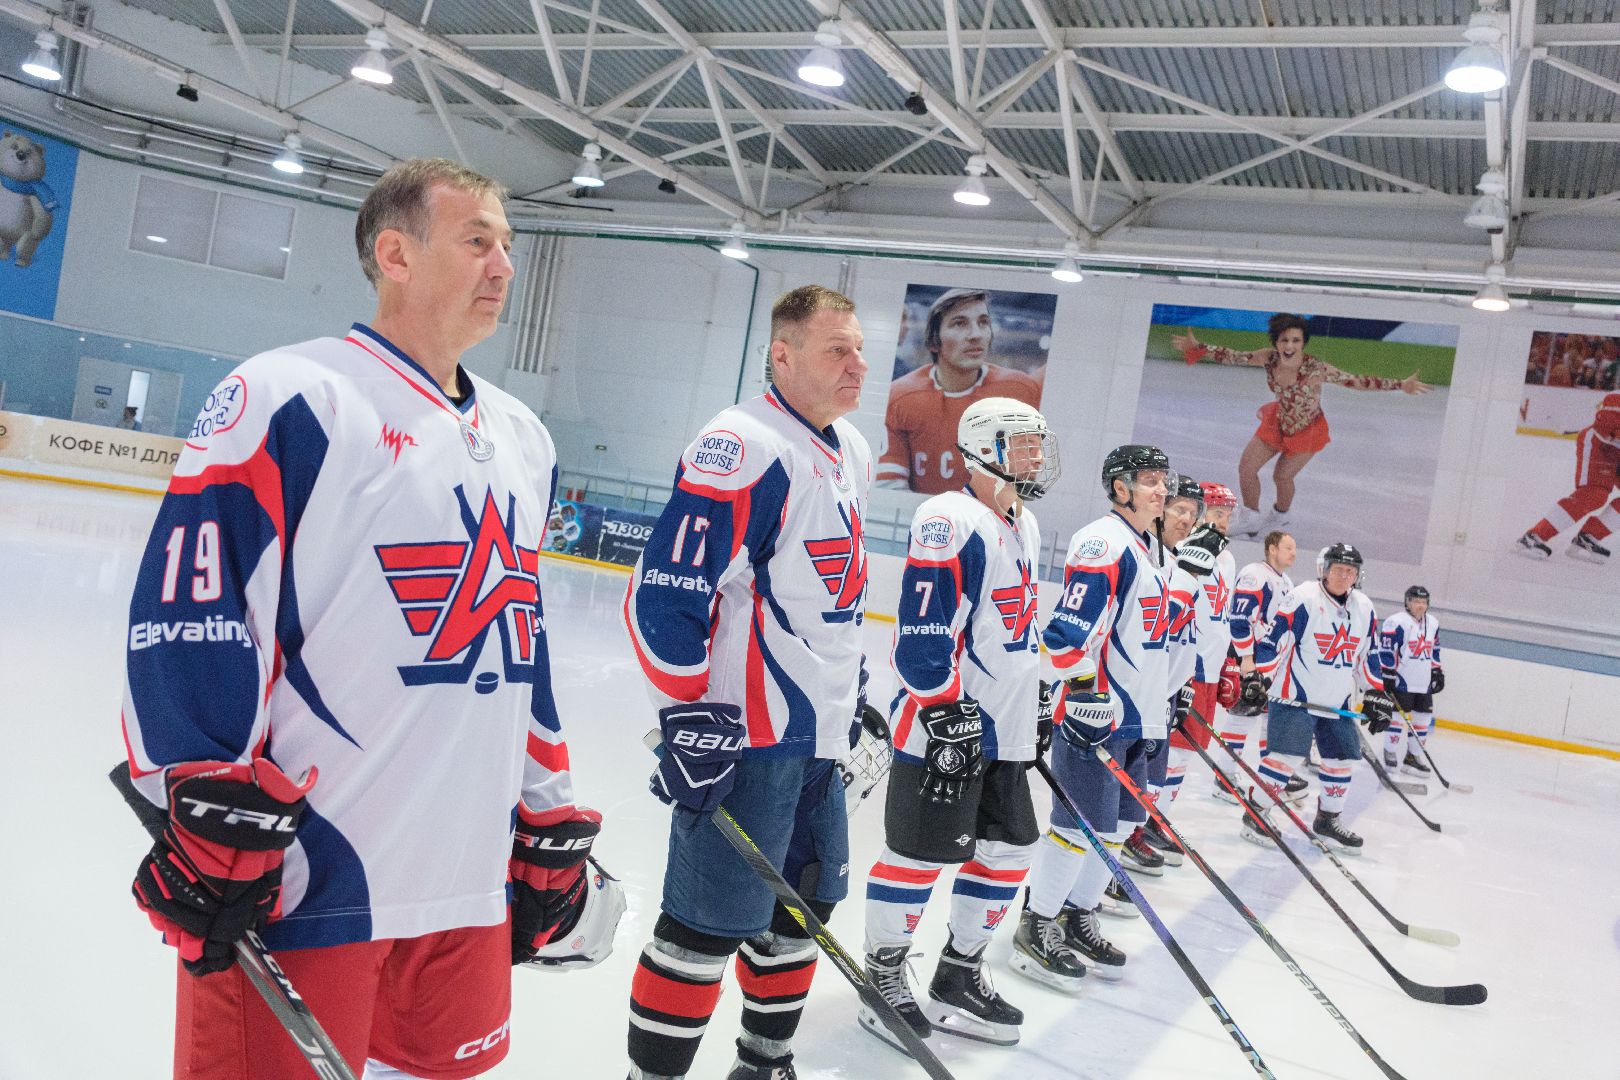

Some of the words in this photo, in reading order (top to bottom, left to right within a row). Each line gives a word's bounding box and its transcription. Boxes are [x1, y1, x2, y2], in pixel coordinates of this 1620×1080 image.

[49, 434, 104, 455] КОФЕ
[109, 443, 137, 459] №1
[140, 448, 179, 465] ДЛЯ
[695, 451, 734, 471] HOUSE
[700, 437, 741, 455] NORTH
[671, 514, 711, 567] 17
[921, 521, 950, 533] NORTH
[161, 520, 223, 603] 19
[915, 581, 934, 617] 7
[1062, 581, 1089, 611] 18
[130, 614, 252, 651] Elevating
[672, 729, 745, 752] BAU
[245, 929, 303, 1001] CCM
